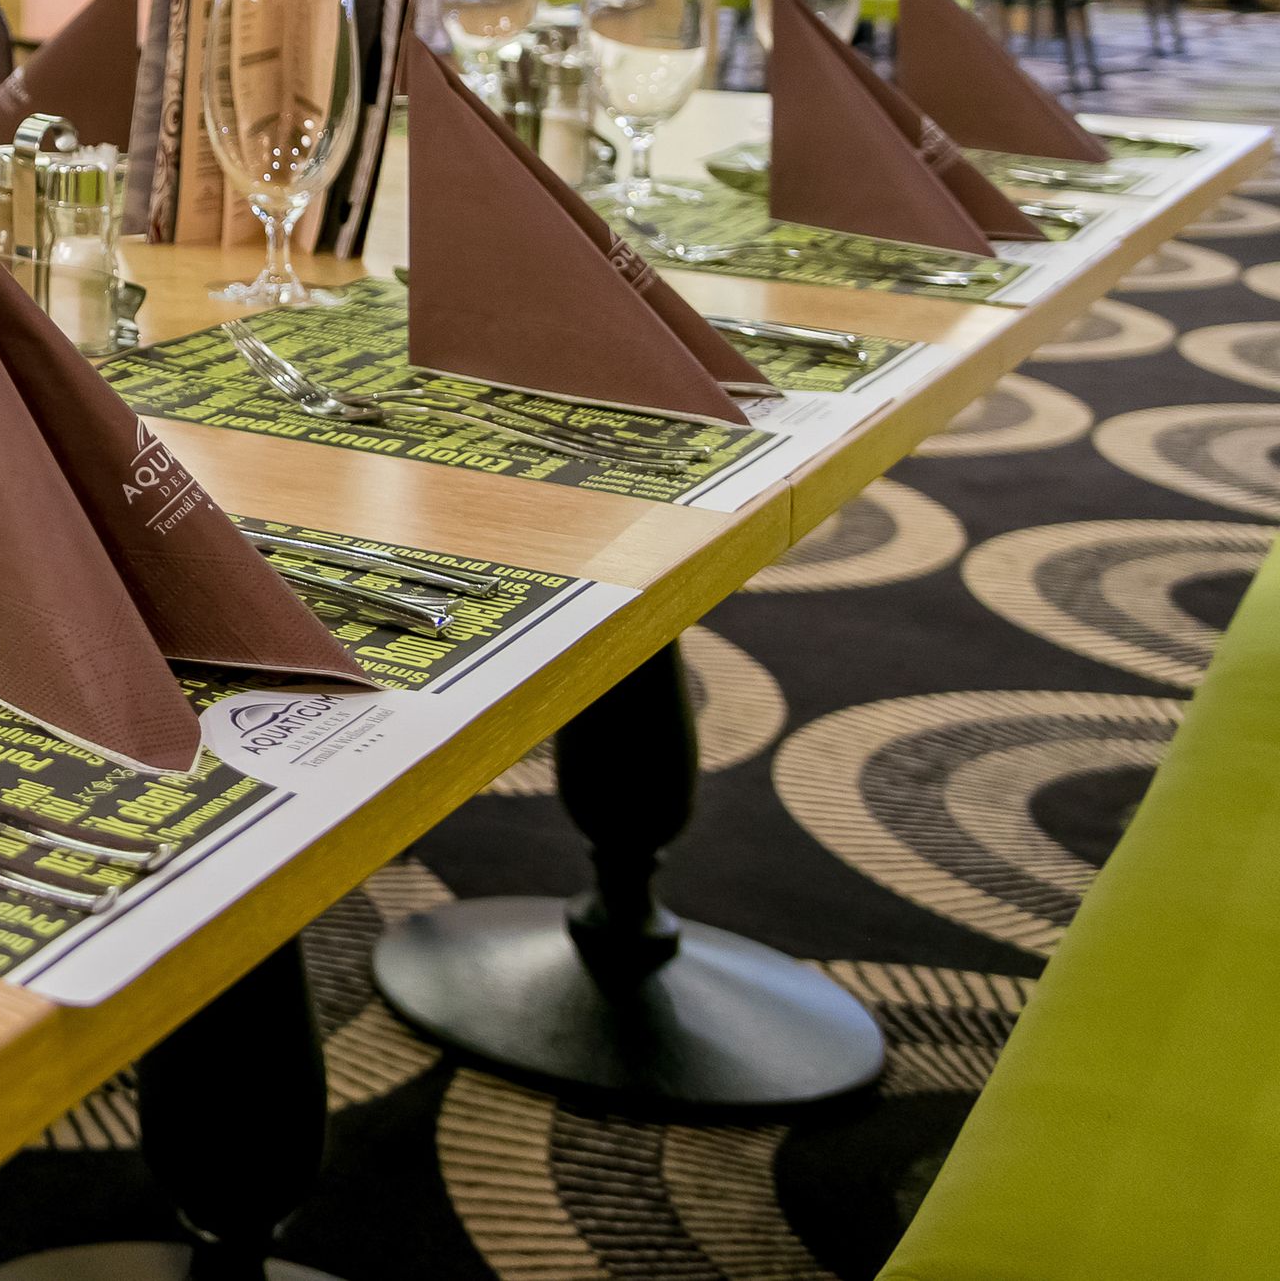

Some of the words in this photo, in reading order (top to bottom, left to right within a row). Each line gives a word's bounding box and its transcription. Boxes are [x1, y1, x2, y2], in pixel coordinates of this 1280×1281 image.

[154, 496, 196, 535] Termál
[491, 565, 568, 589] Buen
[355, 634, 459, 669] Bon
[241, 693, 345, 756] AQUATICUM
[117, 781, 197, 825] eten!
